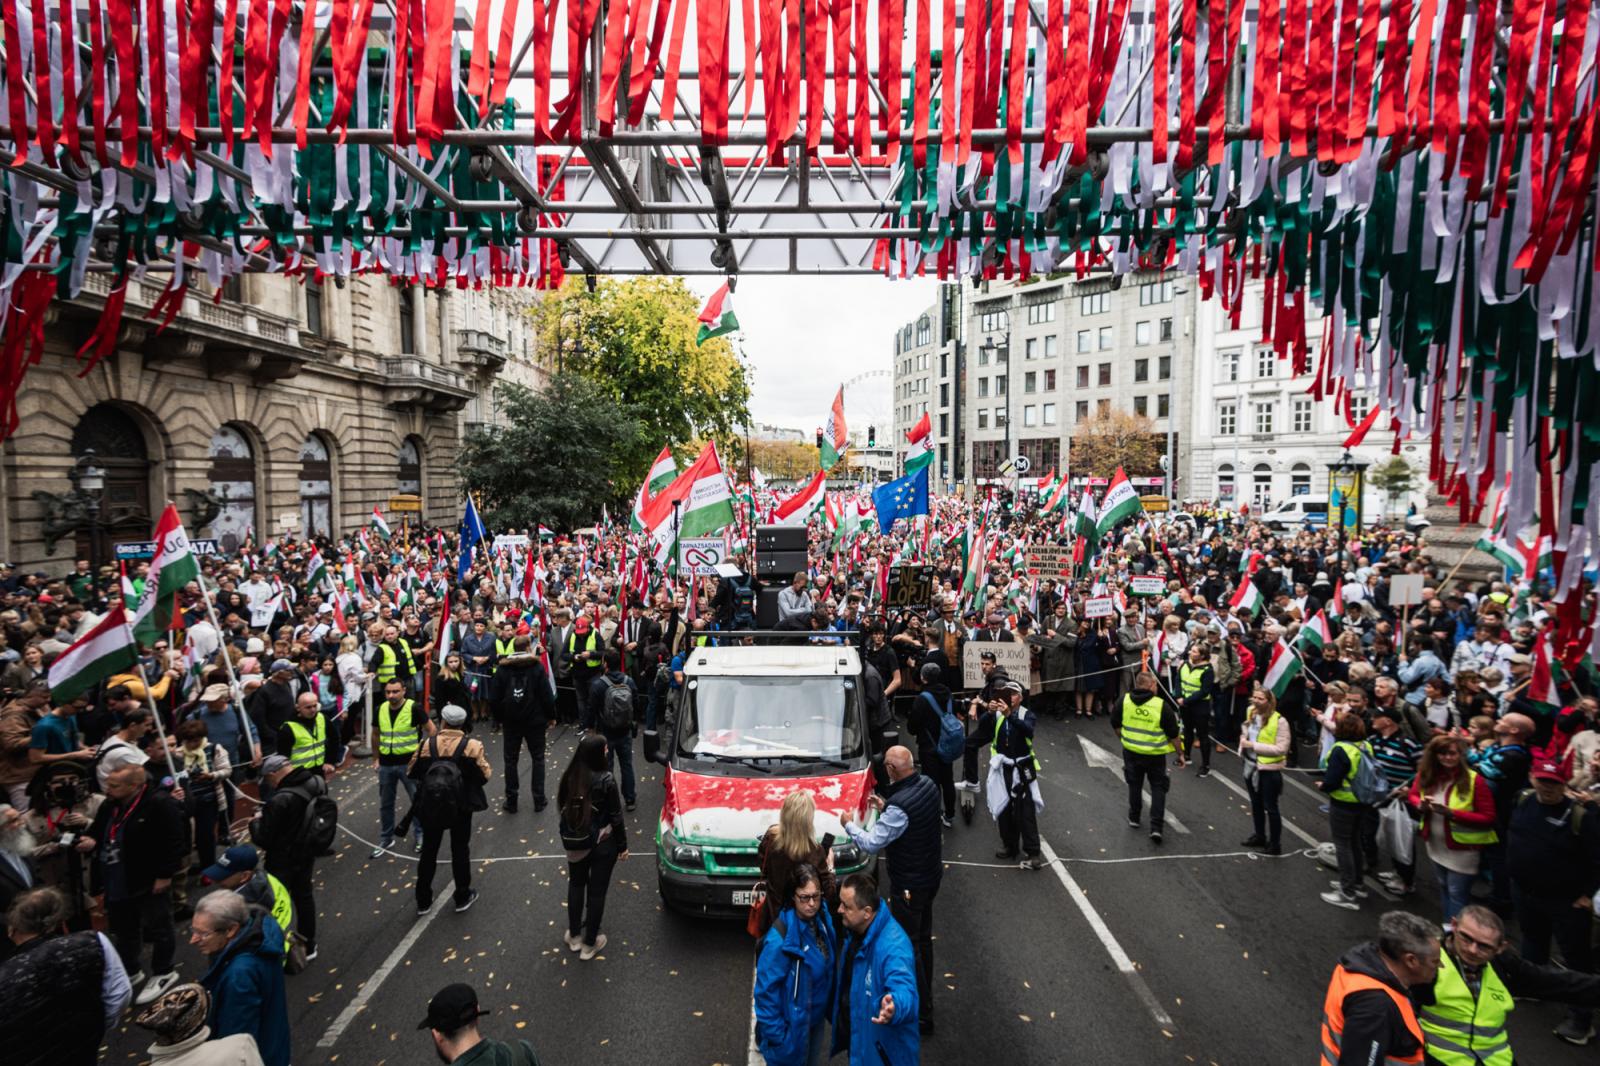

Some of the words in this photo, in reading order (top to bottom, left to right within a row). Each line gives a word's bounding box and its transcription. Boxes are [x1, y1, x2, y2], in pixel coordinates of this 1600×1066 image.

[900, 566, 921, 586] NE
[886, 580, 931, 606] LOPJ!
[966, 647, 974, 657] A
[965, 662, 980, 670] NEM
[965, 671, 978, 681] FEL
